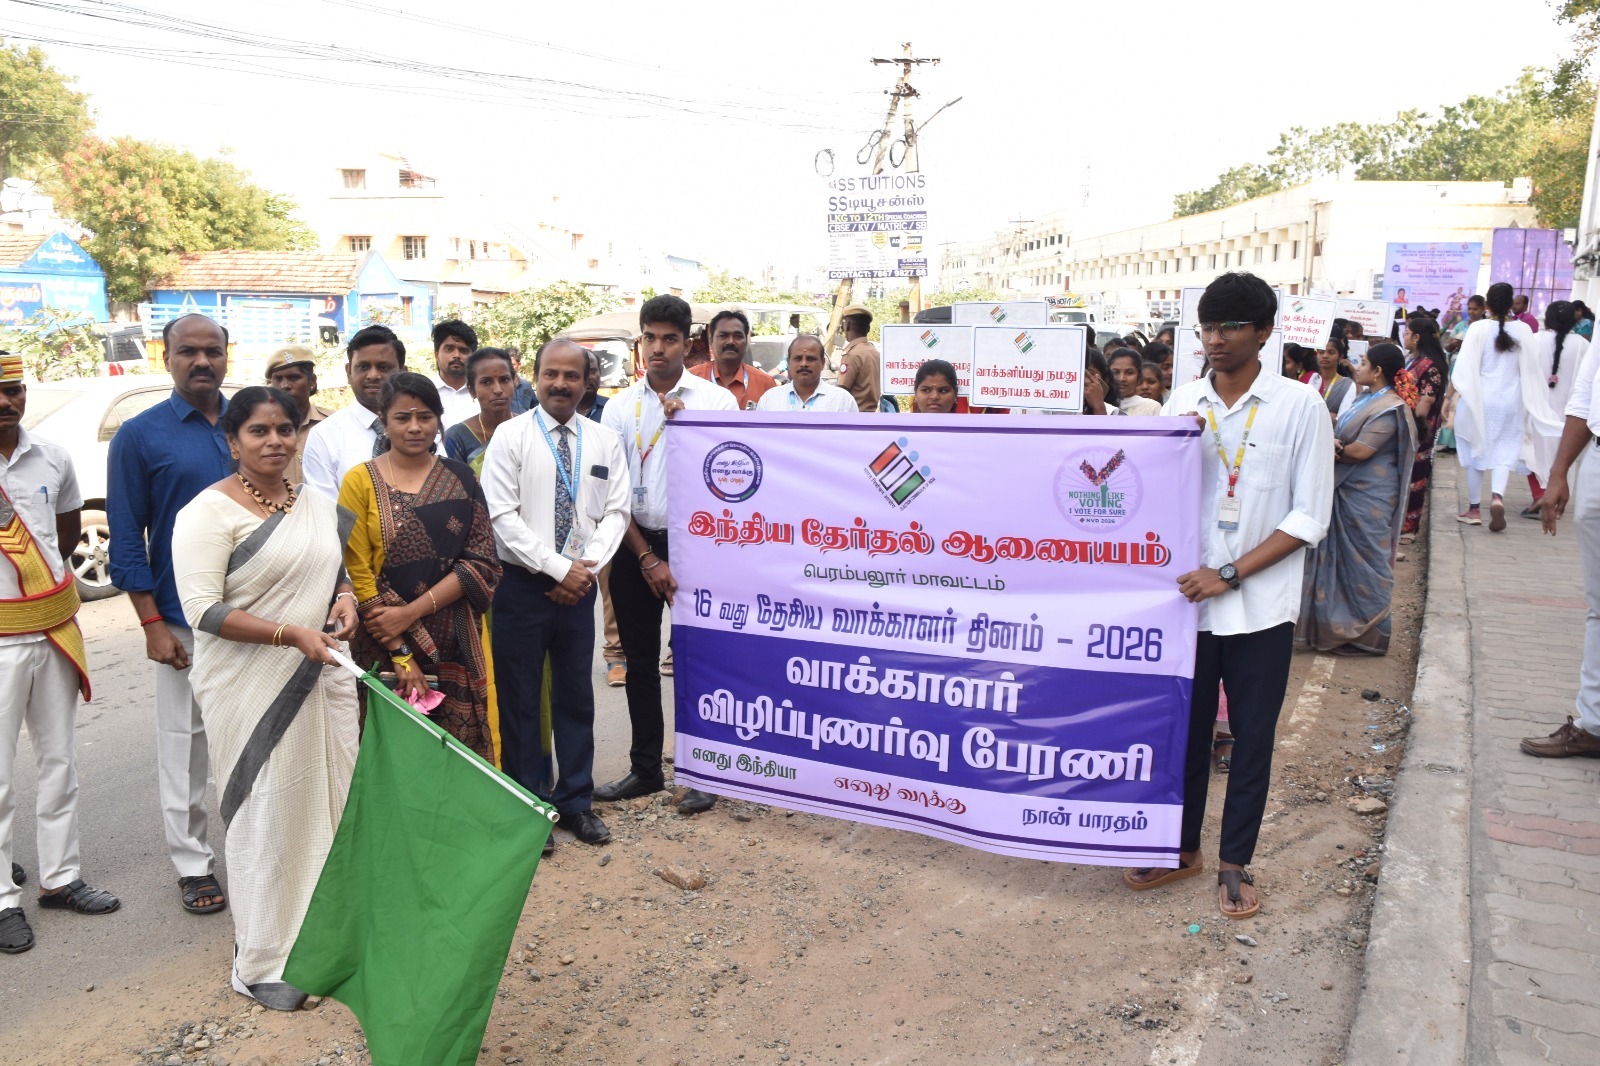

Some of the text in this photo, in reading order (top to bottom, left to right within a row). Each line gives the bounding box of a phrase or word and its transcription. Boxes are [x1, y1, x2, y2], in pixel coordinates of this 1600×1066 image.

[858, 174, 926, 190] TUITIONS
[829, 214, 848, 223] LKG
[849, 214, 861, 222] TO
[864, 212, 884, 222] 12TH
[828, 223, 850, 232] CBSE
[858, 223, 870, 232] KV
[877, 222, 908, 231] MATRIC
[830, 270, 872, 278] CONTACT:
[1292, 314, 1326, 325] இந்தியா
[1294, 325, 1320, 335] வாக்கு
[1288, 335, 1317, 344] பாரதம்
[976, 364, 1077, 384] வாக்களிப்பது நமது
[980, 386, 1070, 399] ஜனநாயக கடமை
[712, 468, 754, 476] எனது வாக்கு
[1068, 491, 1125, 500] NOTHING LIKE
[688, 508, 1172, 567] இந்திய தேர்தல் ஆணையம்
[804, 564, 1006, 591] பெரம்பலூர் மாவட்டம்
[693, 588, 712, 618] 16
[719, 601, 750, 630] வது
[756, 593, 824, 632] தேசிய
[832, 600, 958, 644] வாக்காளர்
[966, 612, 1044, 654] தினம்
[1086, 623, 1163, 662] 2026
[786, 656, 1024, 714] வாக்காளர்
[698, 688, 1154, 782] விழிப்புணர்வு பேரணி
[692, 747, 1148, 833] எனது இந்தியா எனது வாக்கு நான் பாரதம்
